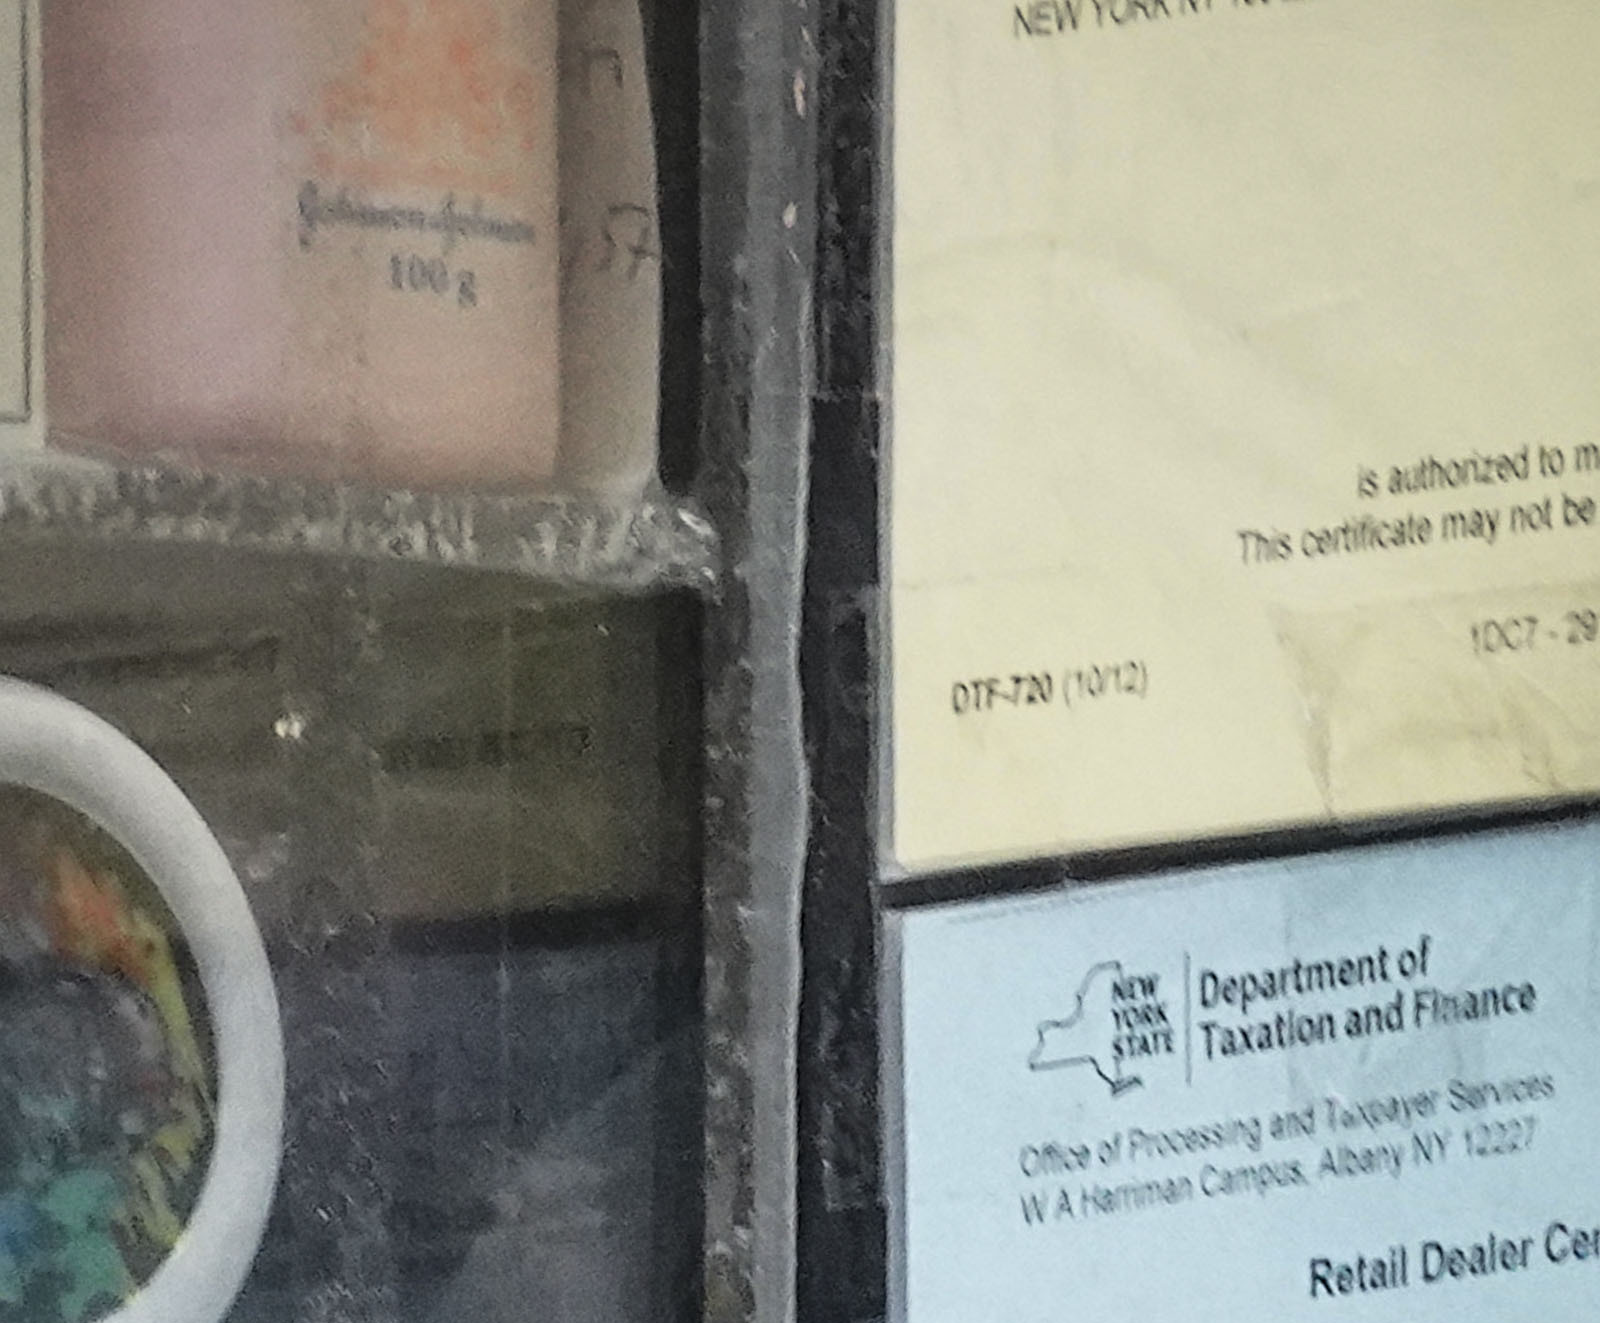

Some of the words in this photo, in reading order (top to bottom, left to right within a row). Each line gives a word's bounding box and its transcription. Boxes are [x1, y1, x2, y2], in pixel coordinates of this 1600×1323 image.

[1358, 463, 1377, 496] is
[1389, 444, 1528, 492] authorized
[1540, 441, 1563, 474] to
[1239, 528, 1291, 563] This
[1301, 511, 1430, 555] certificate
[1442, 509, 1495, 539] may
[1511, 496, 1552, 531] not
[1563, 492, 1594, 524] be
[952, 672, 1052, 715] DTF-720
[1062, 660, 1147, 711] (10/12)
[1111, 974, 1159, 1000] NEW
[1200, 945, 1392, 1013] Department
[1400, 934, 1431, 976] of
[1111, 1003, 1169, 1030] YORK
[1199, 1003, 1336, 1061] Taxation
[1345, 994, 1404, 1039] and
[1414, 978, 1537, 1030] Finance
[1111, 1029, 1174, 1061] STATE
[1309, 1245, 1409, 1300] Retail
[1420, 1232, 1533, 1285] Dealer
